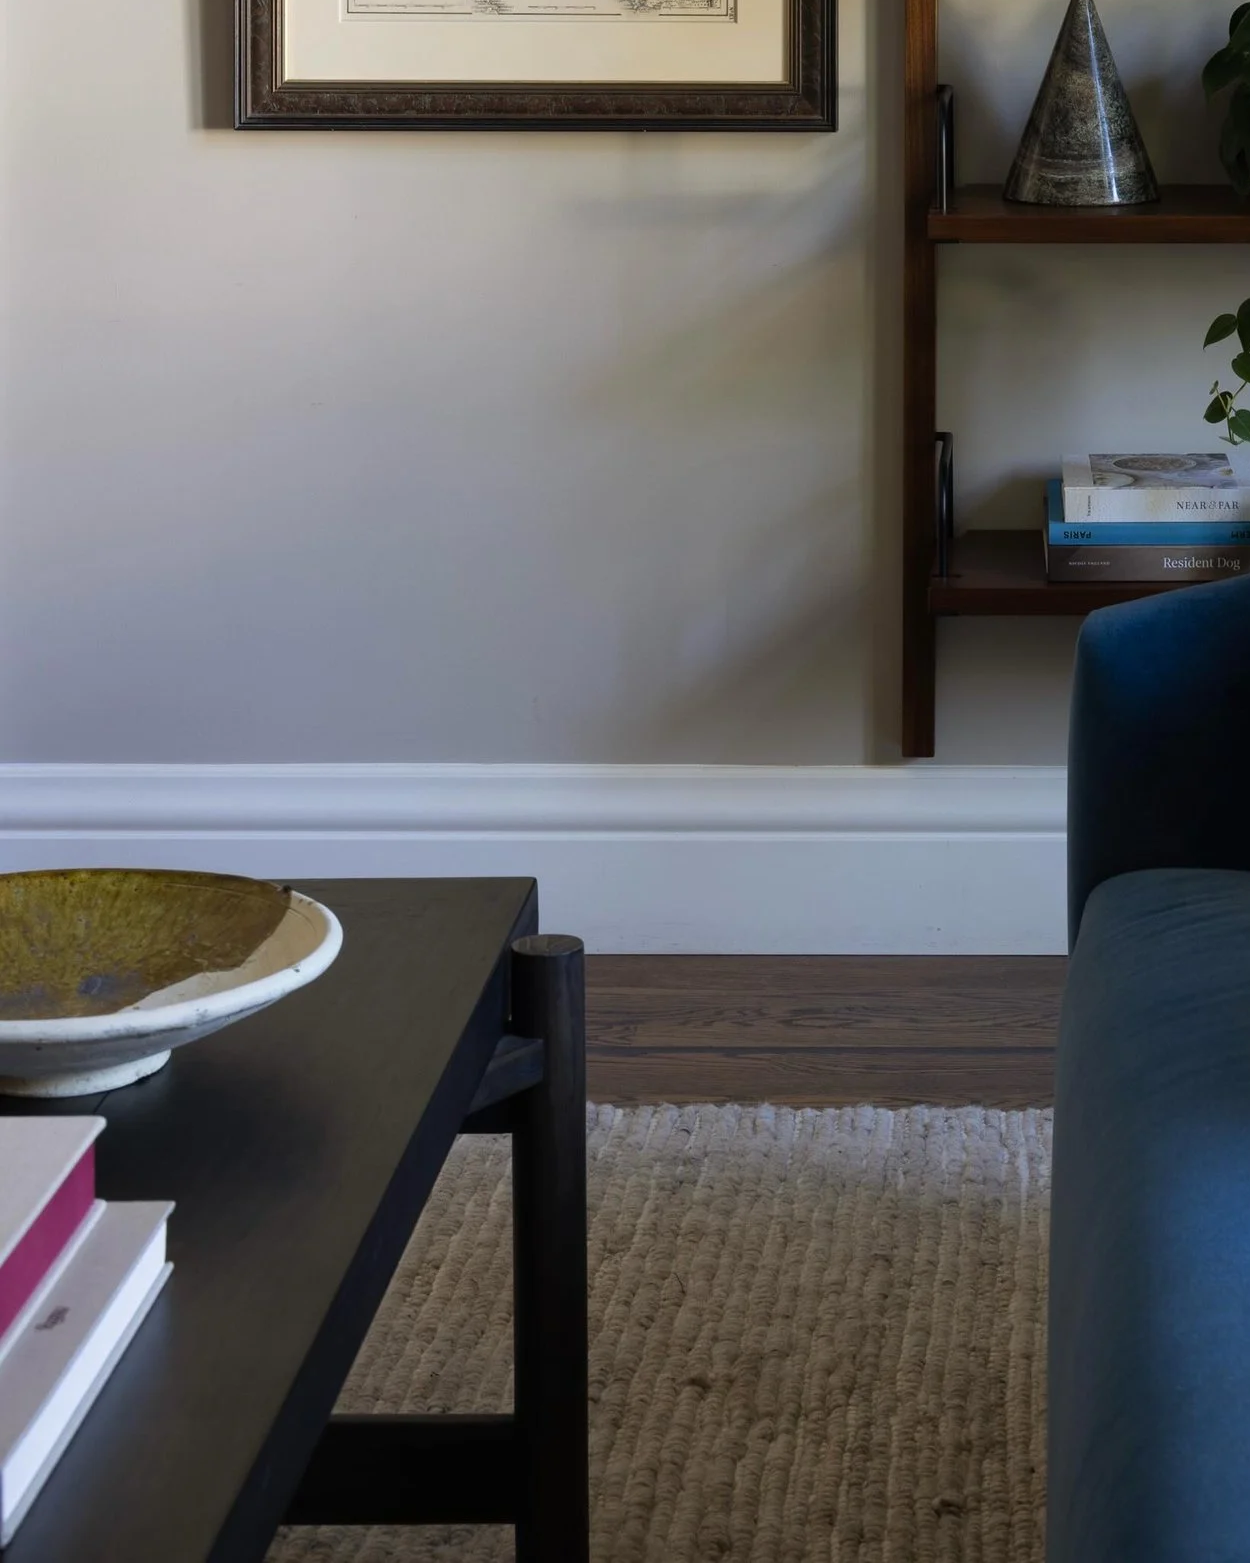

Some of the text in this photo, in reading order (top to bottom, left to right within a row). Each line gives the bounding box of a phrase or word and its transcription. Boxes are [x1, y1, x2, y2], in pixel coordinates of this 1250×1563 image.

[1063, 530, 1092, 539] PARIS
[1163, 556, 1241, 570] Resident Dog
